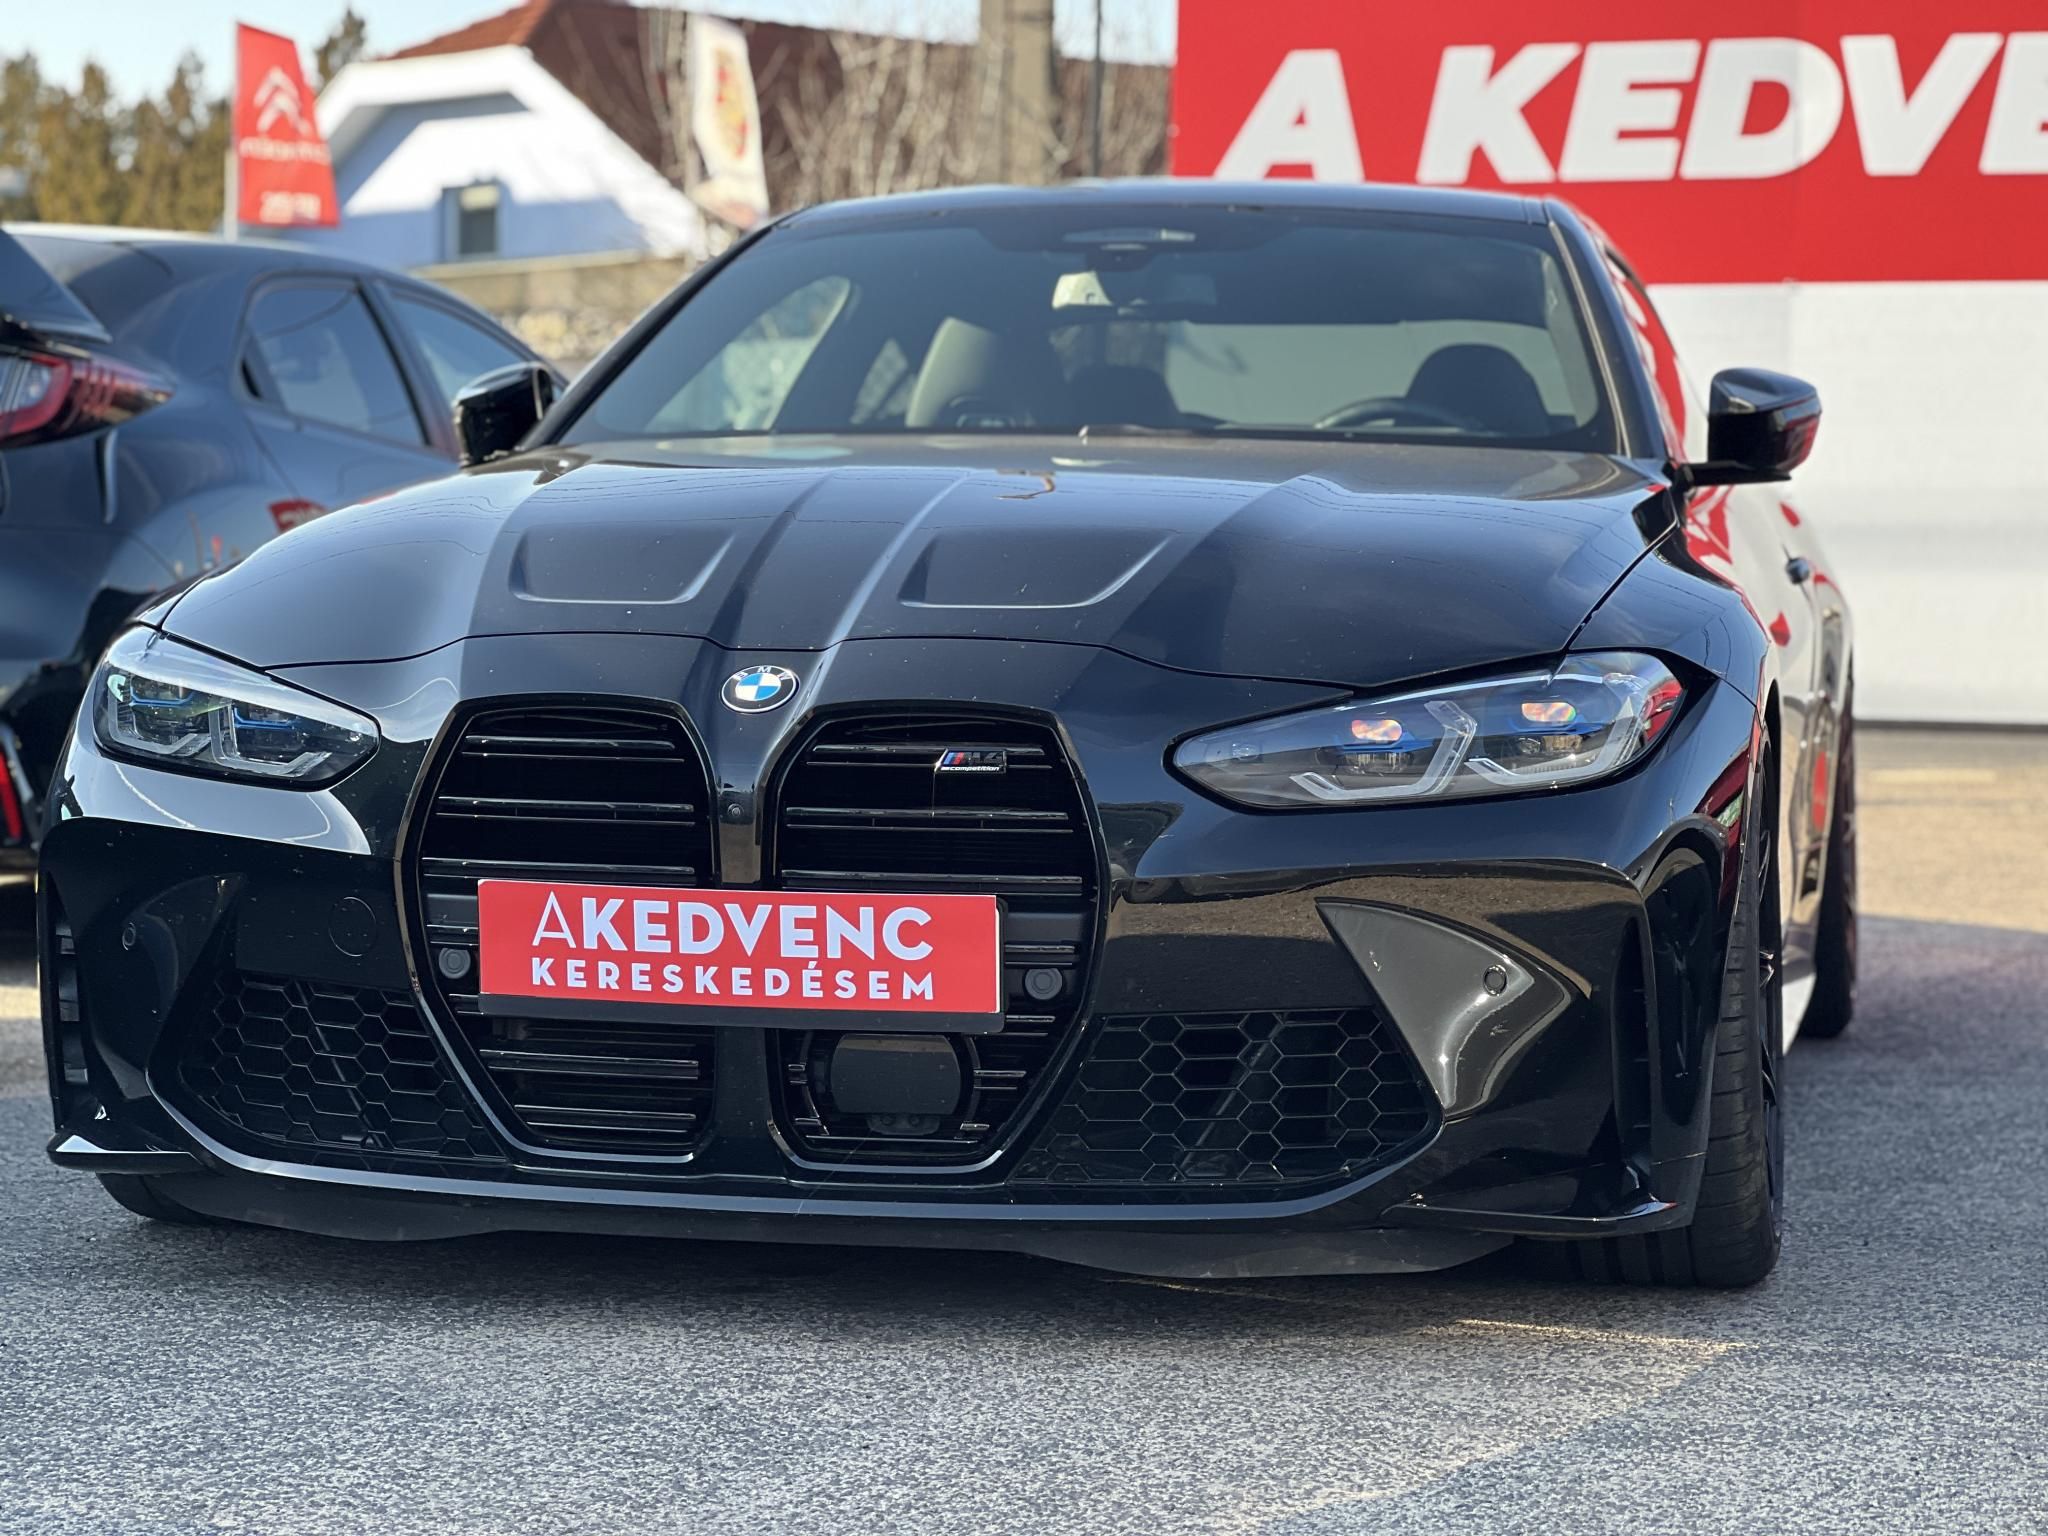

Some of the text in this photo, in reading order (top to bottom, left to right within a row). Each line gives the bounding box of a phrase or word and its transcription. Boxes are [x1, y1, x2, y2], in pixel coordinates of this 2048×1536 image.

[1212, 49, 1365, 182] A
[732, 665, 794, 681] BMW
[531, 956, 935, 1001] KERESKEDÉSEM
